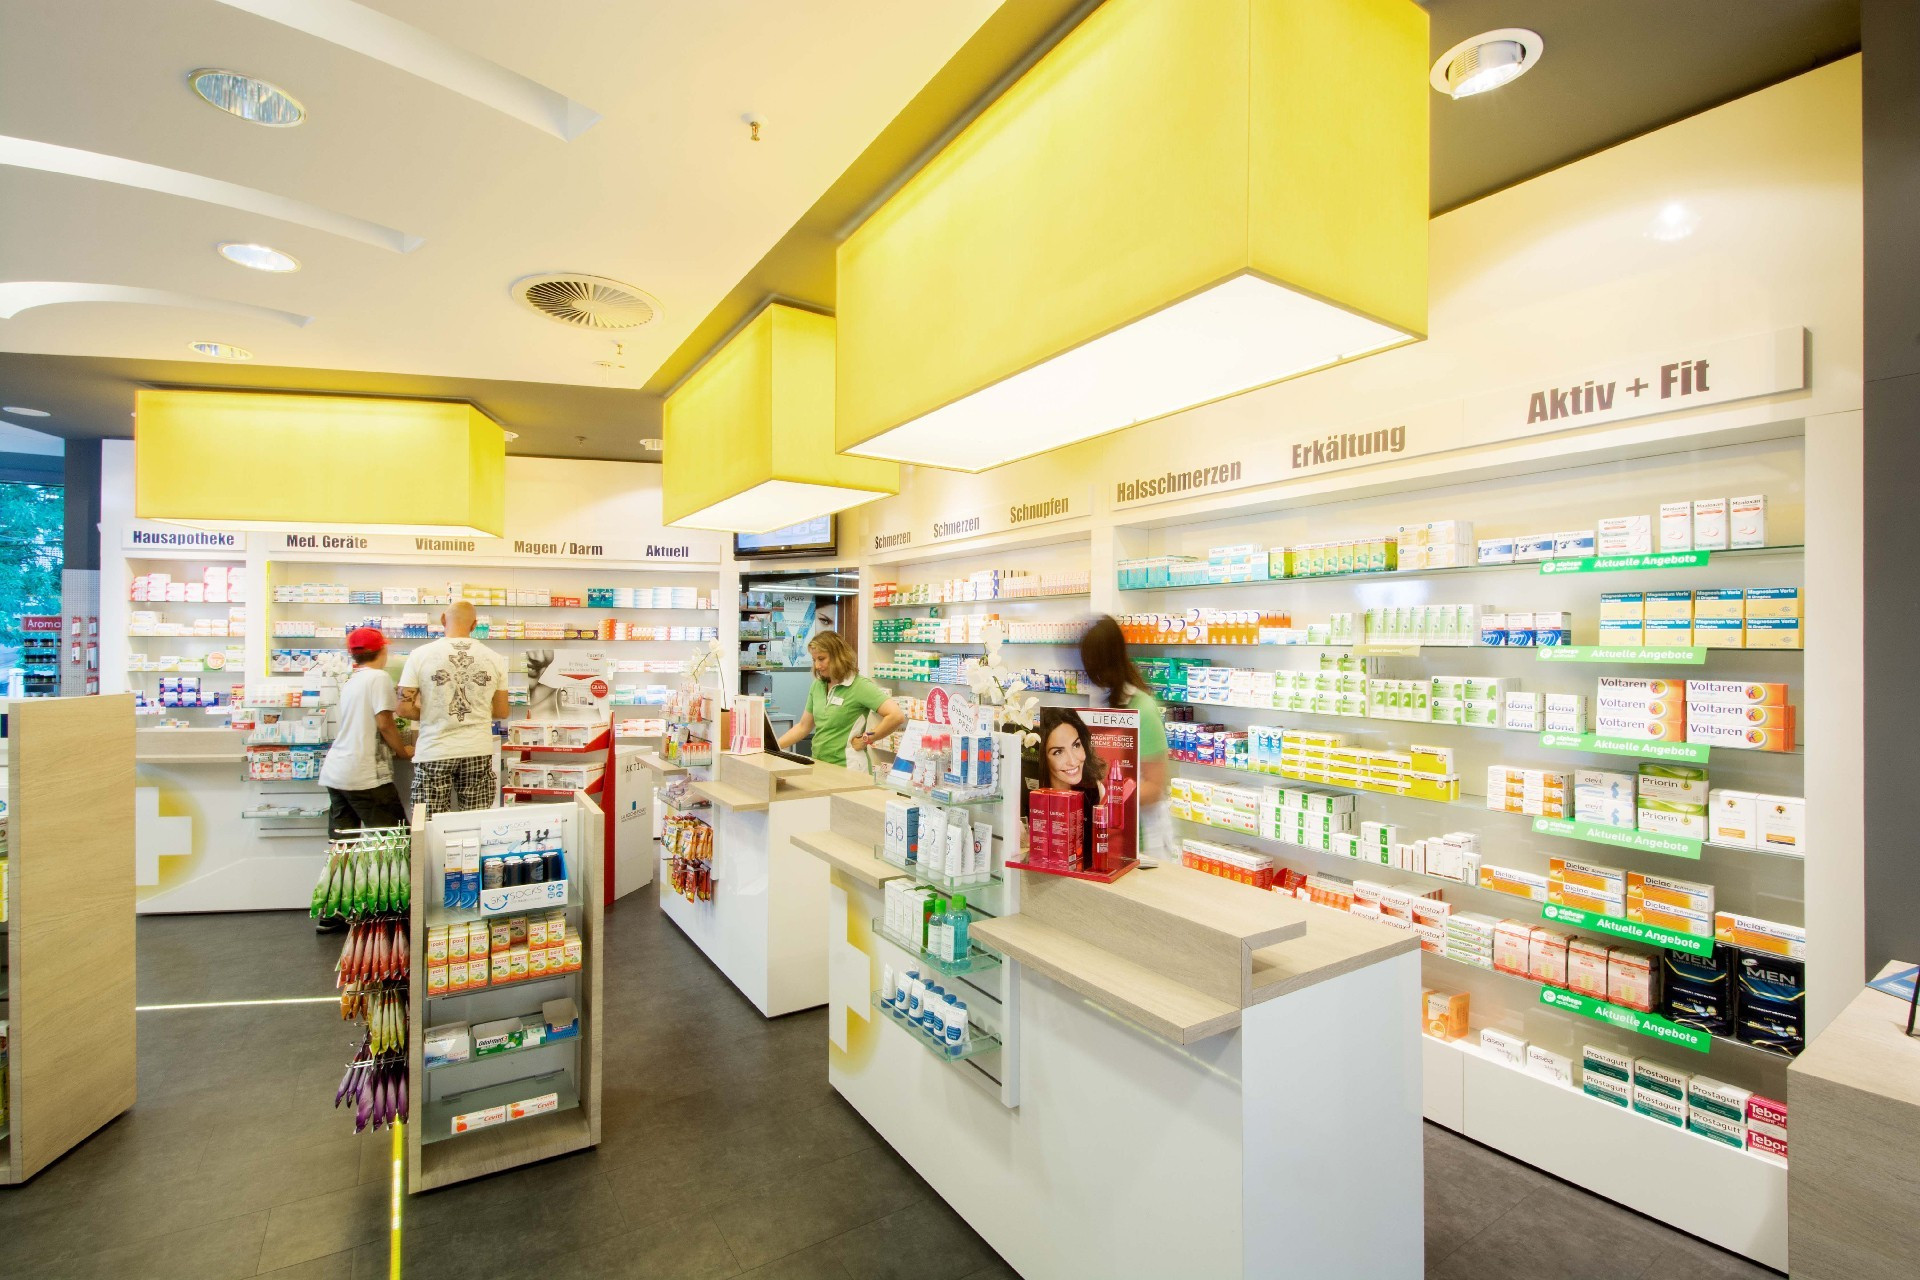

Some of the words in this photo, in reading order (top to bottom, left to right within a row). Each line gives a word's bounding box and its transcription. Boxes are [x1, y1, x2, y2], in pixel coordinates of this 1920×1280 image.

[1526, 380, 1616, 425] Aktiv
[1625, 377, 1649, 398] +
[1660, 359, 1710, 399] Fit
[1291, 425, 1406, 469] Erkältung
[1116, 460, 1242, 503] Halsschmerzen
[1009, 497, 1069, 524] Schnupfen
[933, 516, 980, 538] Schmerzen
[133, 530, 235, 547] Hausapotheke
[286, 534, 318, 549] Med.
[322, 535, 368, 549] Geräte
[415, 536, 476, 552] Vitamine
[874, 530, 911, 550] Schmerzen
[514, 540, 557, 558] Magen
[560, 541, 567, 556] /
[569, 542, 603, 556] Darm
[645, 544, 689, 558] Aktuell
[1594, 555, 1639, 569] Aktuelle
[1641, 554, 1697, 567] Angebote
[1591, 650, 1636, 659] Aktuelle
[1638, 649, 1694, 662] Angebote
[1600, 677, 1647, 689] Voltaren
[1689, 681, 1742, 693] Voltaren
[1507, 700, 1533, 710] dona
[1548, 702, 1575, 712] dona
[1599, 698, 1646, 709] Voltaren
[1690, 702, 1743, 715] Voltaren
[1092, 715, 1135, 726] LIERAC
[1507, 718, 1533, 729] dona
[1547, 721, 1575, 732] dona
[1598, 717, 1645, 729] Voltaren
[1690, 723, 1743, 737] Voltaren
[1090, 734, 1134, 743] MAGNIFICENCE
[1593, 739, 1640, 752] Aktuelle
[1641, 744, 1697, 757] Angebote
[1642, 776, 1678, 788] Priorin
[1641, 811, 1678, 823] Priorin
[1586, 828, 1633, 843] Aktuelle
[1634, 834, 1689, 852] Angebote
[1565, 861, 1589, 872] Diclac
[1495, 870, 1516, 880] Diclac
[1645, 876, 1672, 888] Diclac
[491, 885, 543, 905] SKYSOCKS
[1564, 884, 1589, 895] Diclac
[1414, 903, 1441, 915] Antistax
[1645, 900, 1671, 912] Diclac
[1381, 919, 1406, 930] Antistax
[1736, 919, 1766, 932] Diclac
[1414, 927, 1441, 939] Antistax
[1596, 918, 1643, 936] Aktuelle
[1644, 928, 1701, 950] Angebote
[1672, 949, 1717, 969] MEN
[1746, 966, 1796, 986] MEN
[1594, 1005, 1640, 1027] Aktuelle
[1642, 1019, 1698, 1044] Angebote
[1482, 1033, 1505, 1048] Lasea
[1529, 1050, 1554, 1065] Lasea
[1586, 1049, 1628, 1068] Prostagutt
[1637, 1064, 1682, 1086] Prostagutt
[1585, 1074, 1627, 1095] Prostagutt
[1637, 1091, 1682, 1113] Prostagutt
[1692, 1083, 1740, 1106] Prostagutt
[1693, 1111, 1741, 1135] Prostagutt
